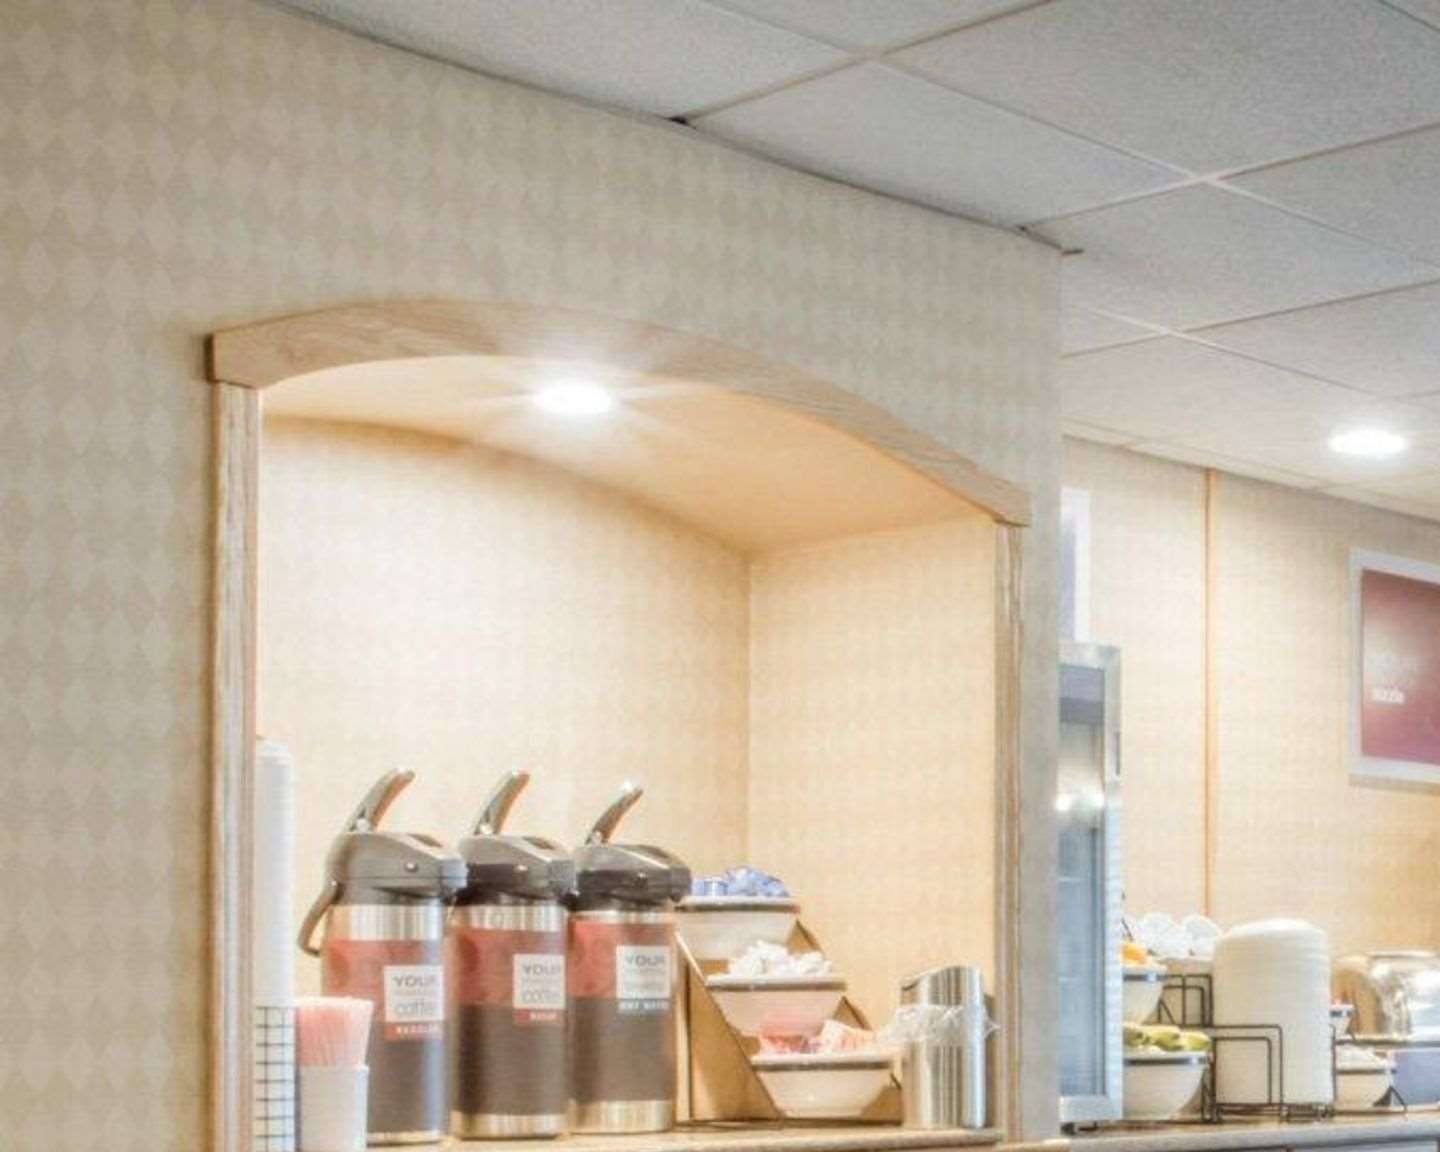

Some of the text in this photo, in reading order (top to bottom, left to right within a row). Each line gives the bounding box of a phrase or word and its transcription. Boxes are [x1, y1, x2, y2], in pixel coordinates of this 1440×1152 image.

[626, 954, 664, 968] YOUR
[523, 963, 561, 976] YOUR
[392, 975, 435, 988] YOUR
